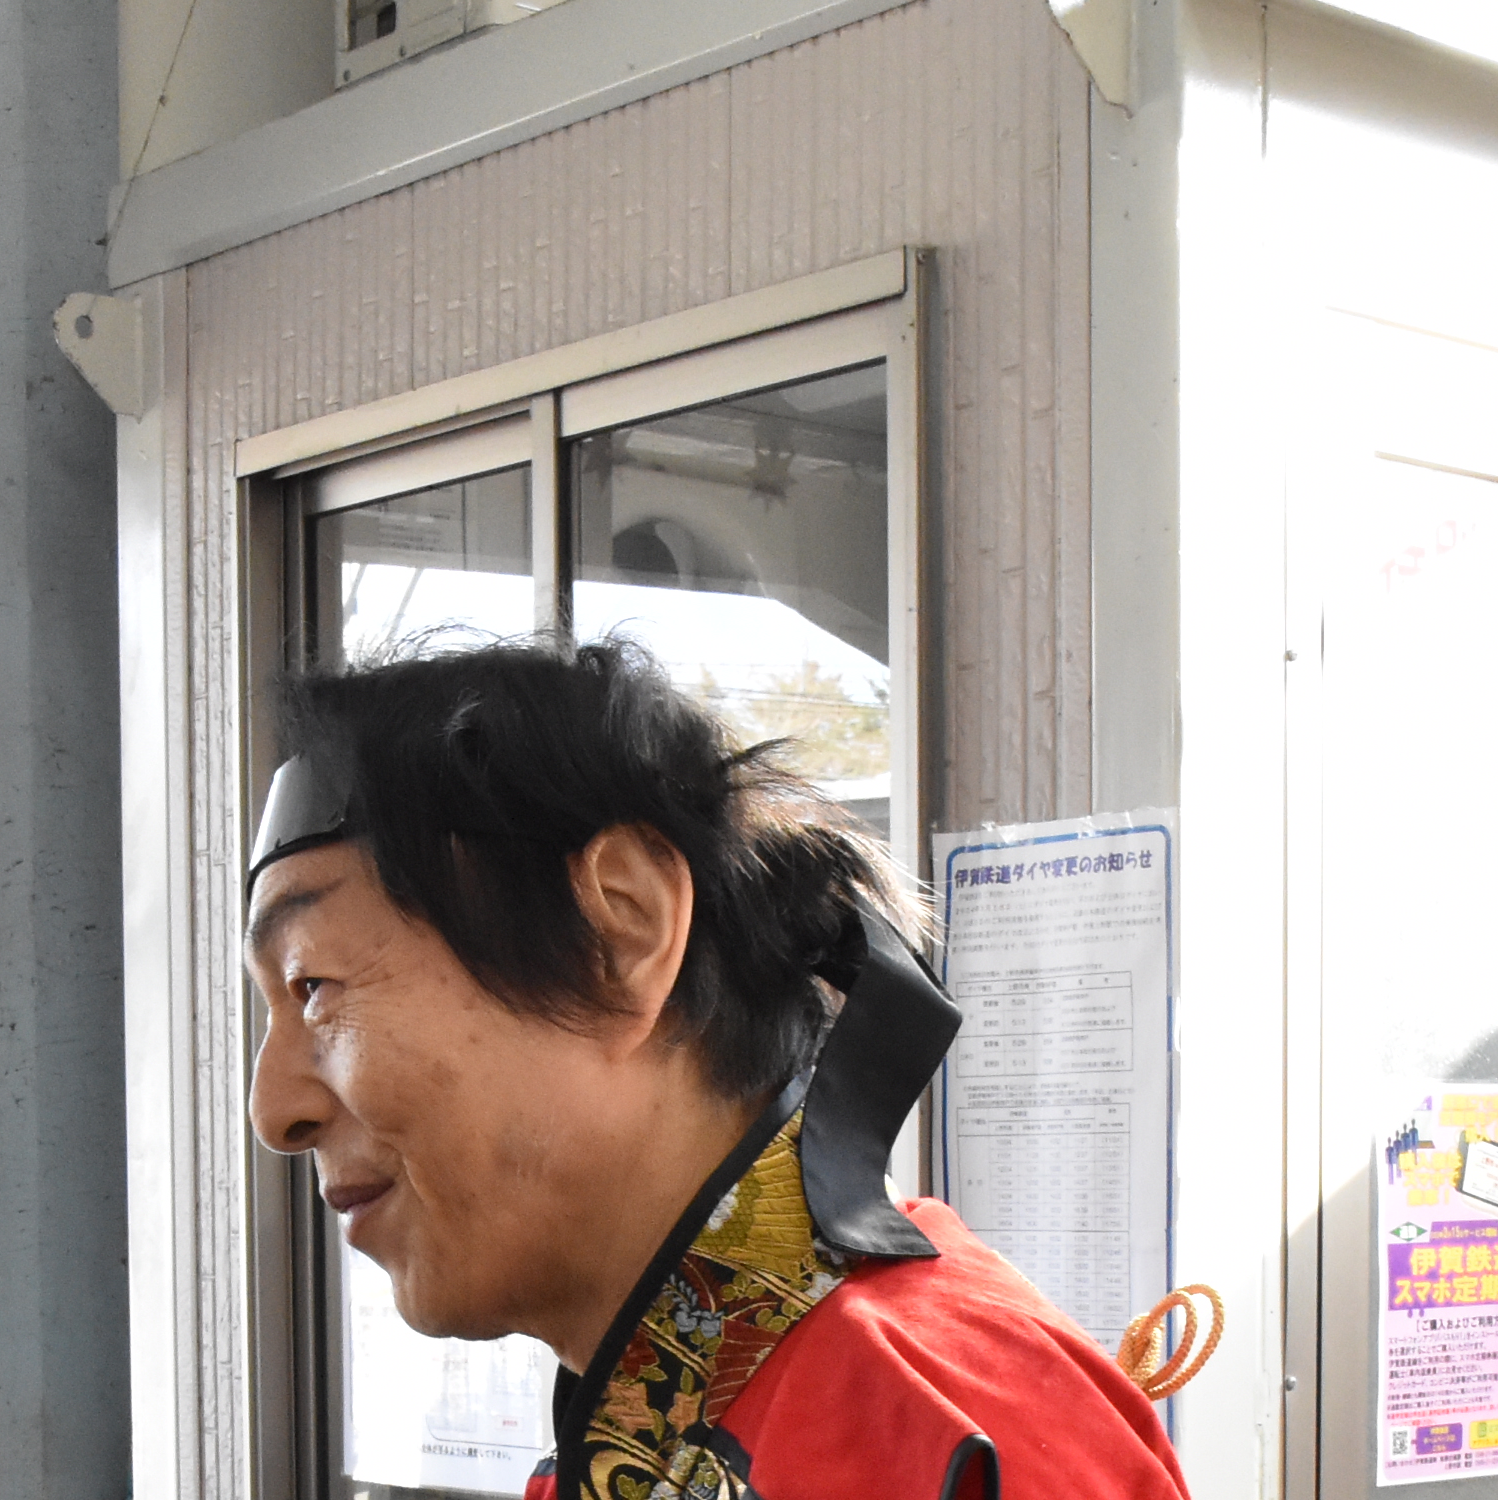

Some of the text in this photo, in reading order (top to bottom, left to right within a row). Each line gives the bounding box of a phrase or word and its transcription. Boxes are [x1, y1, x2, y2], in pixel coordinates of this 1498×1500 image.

[954, 850, 1153, 888] 伊賀鉄道ダイヤ変更のお知らせ
